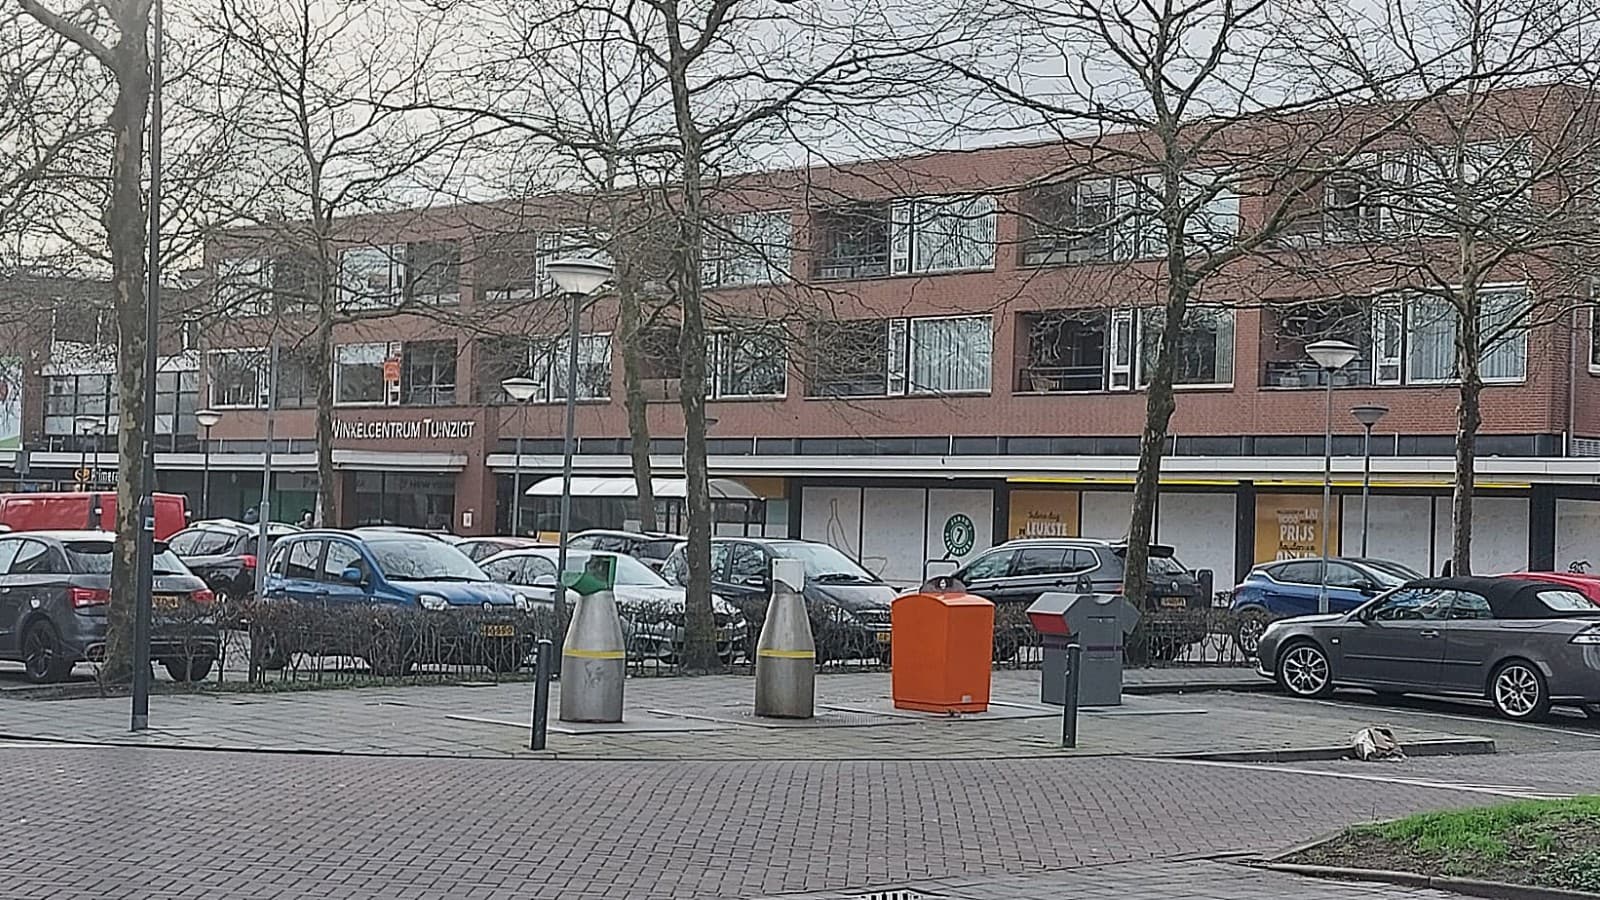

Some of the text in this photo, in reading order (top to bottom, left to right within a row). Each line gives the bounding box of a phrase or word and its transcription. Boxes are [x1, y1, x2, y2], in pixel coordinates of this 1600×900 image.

[423, 418, 475, 438] TUINZIGT
[956, 527, 964, 543] 7
[1026, 520, 1068, 537] LEUKSTE
[1279, 524, 1315, 541] PRIJS
